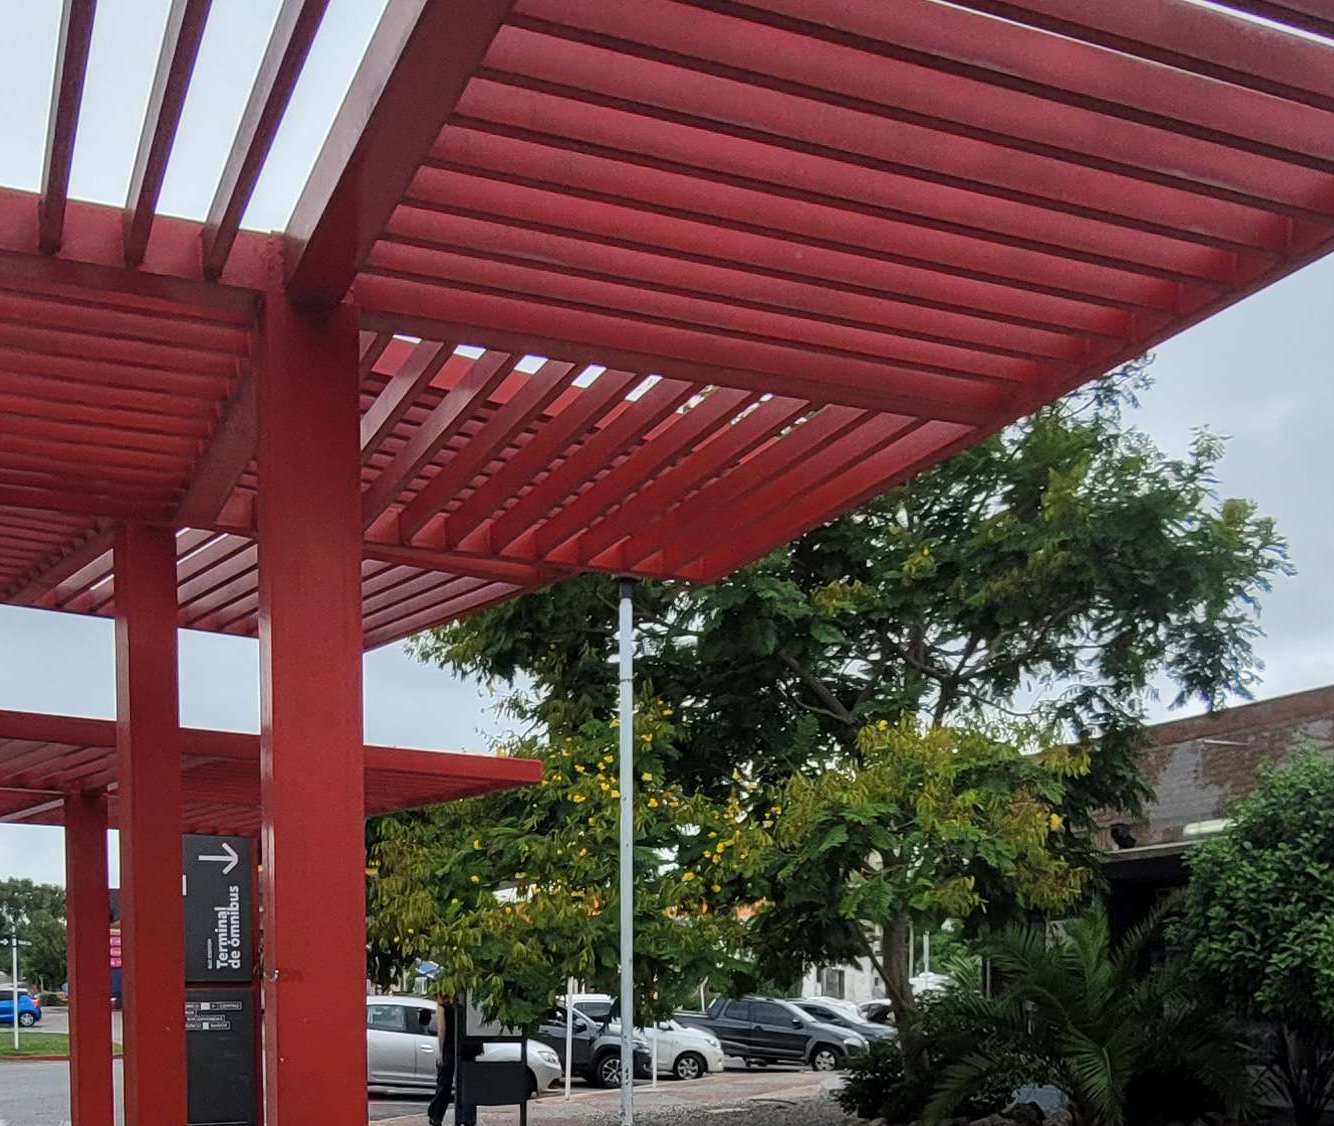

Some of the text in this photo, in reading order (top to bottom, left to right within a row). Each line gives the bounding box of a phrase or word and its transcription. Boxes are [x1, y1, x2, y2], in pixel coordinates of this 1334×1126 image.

[214, 907, 228, 969] Terminal
[227, 885, 241, 969] de ómnibus
